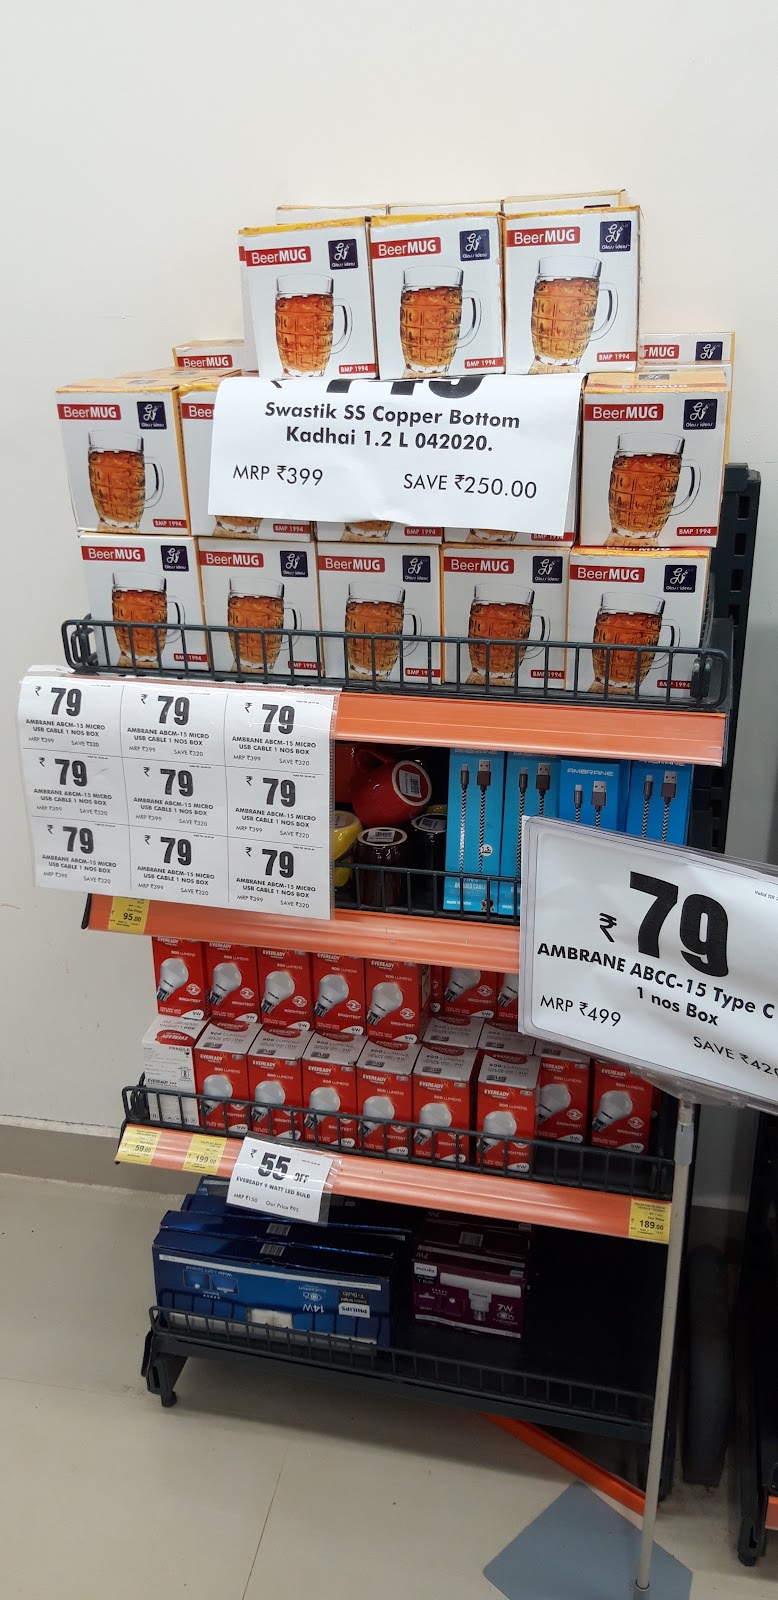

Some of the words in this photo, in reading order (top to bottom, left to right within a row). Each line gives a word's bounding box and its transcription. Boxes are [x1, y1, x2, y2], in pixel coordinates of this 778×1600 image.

[514, 229, 575, 244] BeerMUG
[379, 240, 436, 257] BeerMUG
[252, 248, 306, 264] BeerMUG
[183, 356, 229, 368] BeerMUG
[64, 406, 117, 419] BeerMUG
[265, 402, 337, 420] Swastik
[344, 404, 366, 420] SS
[373, 406, 442, 427] Copper
[450, 409, 520, 428] Bottom
[593, 406, 657, 419] BeerMUG
[286, 426, 355, 446] Kadhai
[364, 430, 392, 447] 1.2
[400, 432, 408, 448] L
[415, 433, 493, 451] 042020.
[233, 465, 270, 481] MRP
[277, 466, 323, 486] ₹399
[404, 473, 448, 490] SAVE
[454, 474, 537, 498] ₹250.00
[88, 547, 141, 560] BeerMUG
[206, 553, 259, 566] BeerMUG
[325, 558, 380, 571] BeerMUG
[451, 559, 509, 571] BeerMUG
[578, 568, 639, 580] BeerMUG
[51, 687, 82, 716] 79
[158, 696, 190, 725] 79
[262, 704, 295, 734] 79
[55, 759, 87, 786] 79
[567, 768, 614, 776] AMBRANE
[160, 768, 193, 797] 79
[263, 778, 295, 807] 79
[63, 826, 94, 854] 79
[160, 837, 191, 866] 79
[262, 849, 294, 878] 79
[236, 877, 265, 885] AMBRANE
[268, 881, 294, 889] ABCM-15
[123, 912, 142, 922] 95.00
[629, 870, 729, 978] 79
[371, 960, 394, 968] EVEREADY
[537, 942, 626, 973] AMBRANE
[630, 963, 707, 998] ABCC-15
[713, 986, 756, 1014] Type
[763, 1003, 774, 1019] C
[540, 994, 574, 1012] MRP
[579, 1002, 622, 1027] ₹499
[637, 986, 644, 999] 1
[651, 994, 680, 1012] nos
[686, 1003, 718, 1026] Box
[693, 1036, 734, 1060] SAVE
[253, 1060, 275, 1068] EVEREADY
[308, 1065, 332, 1074] EVEREADY
[362, 1074, 386, 1083] EVEREADY
[602, 1068, 627, 1078] EVEREADY
[419, 1080, 443, 1089] EVEREADY
[484, 1088, 510, 1097] EVEREADY
[258, 1152, 291, 1180] 55
[237, 1176, 262, 1187] EVEREADY
[640, 1220, 663, 1230] 189.00
[303, 1303, 325, 1313] 14W
[341, 1306, 367, 1314] PHILIPS
[498, 1304, 513, 1312] 7W
